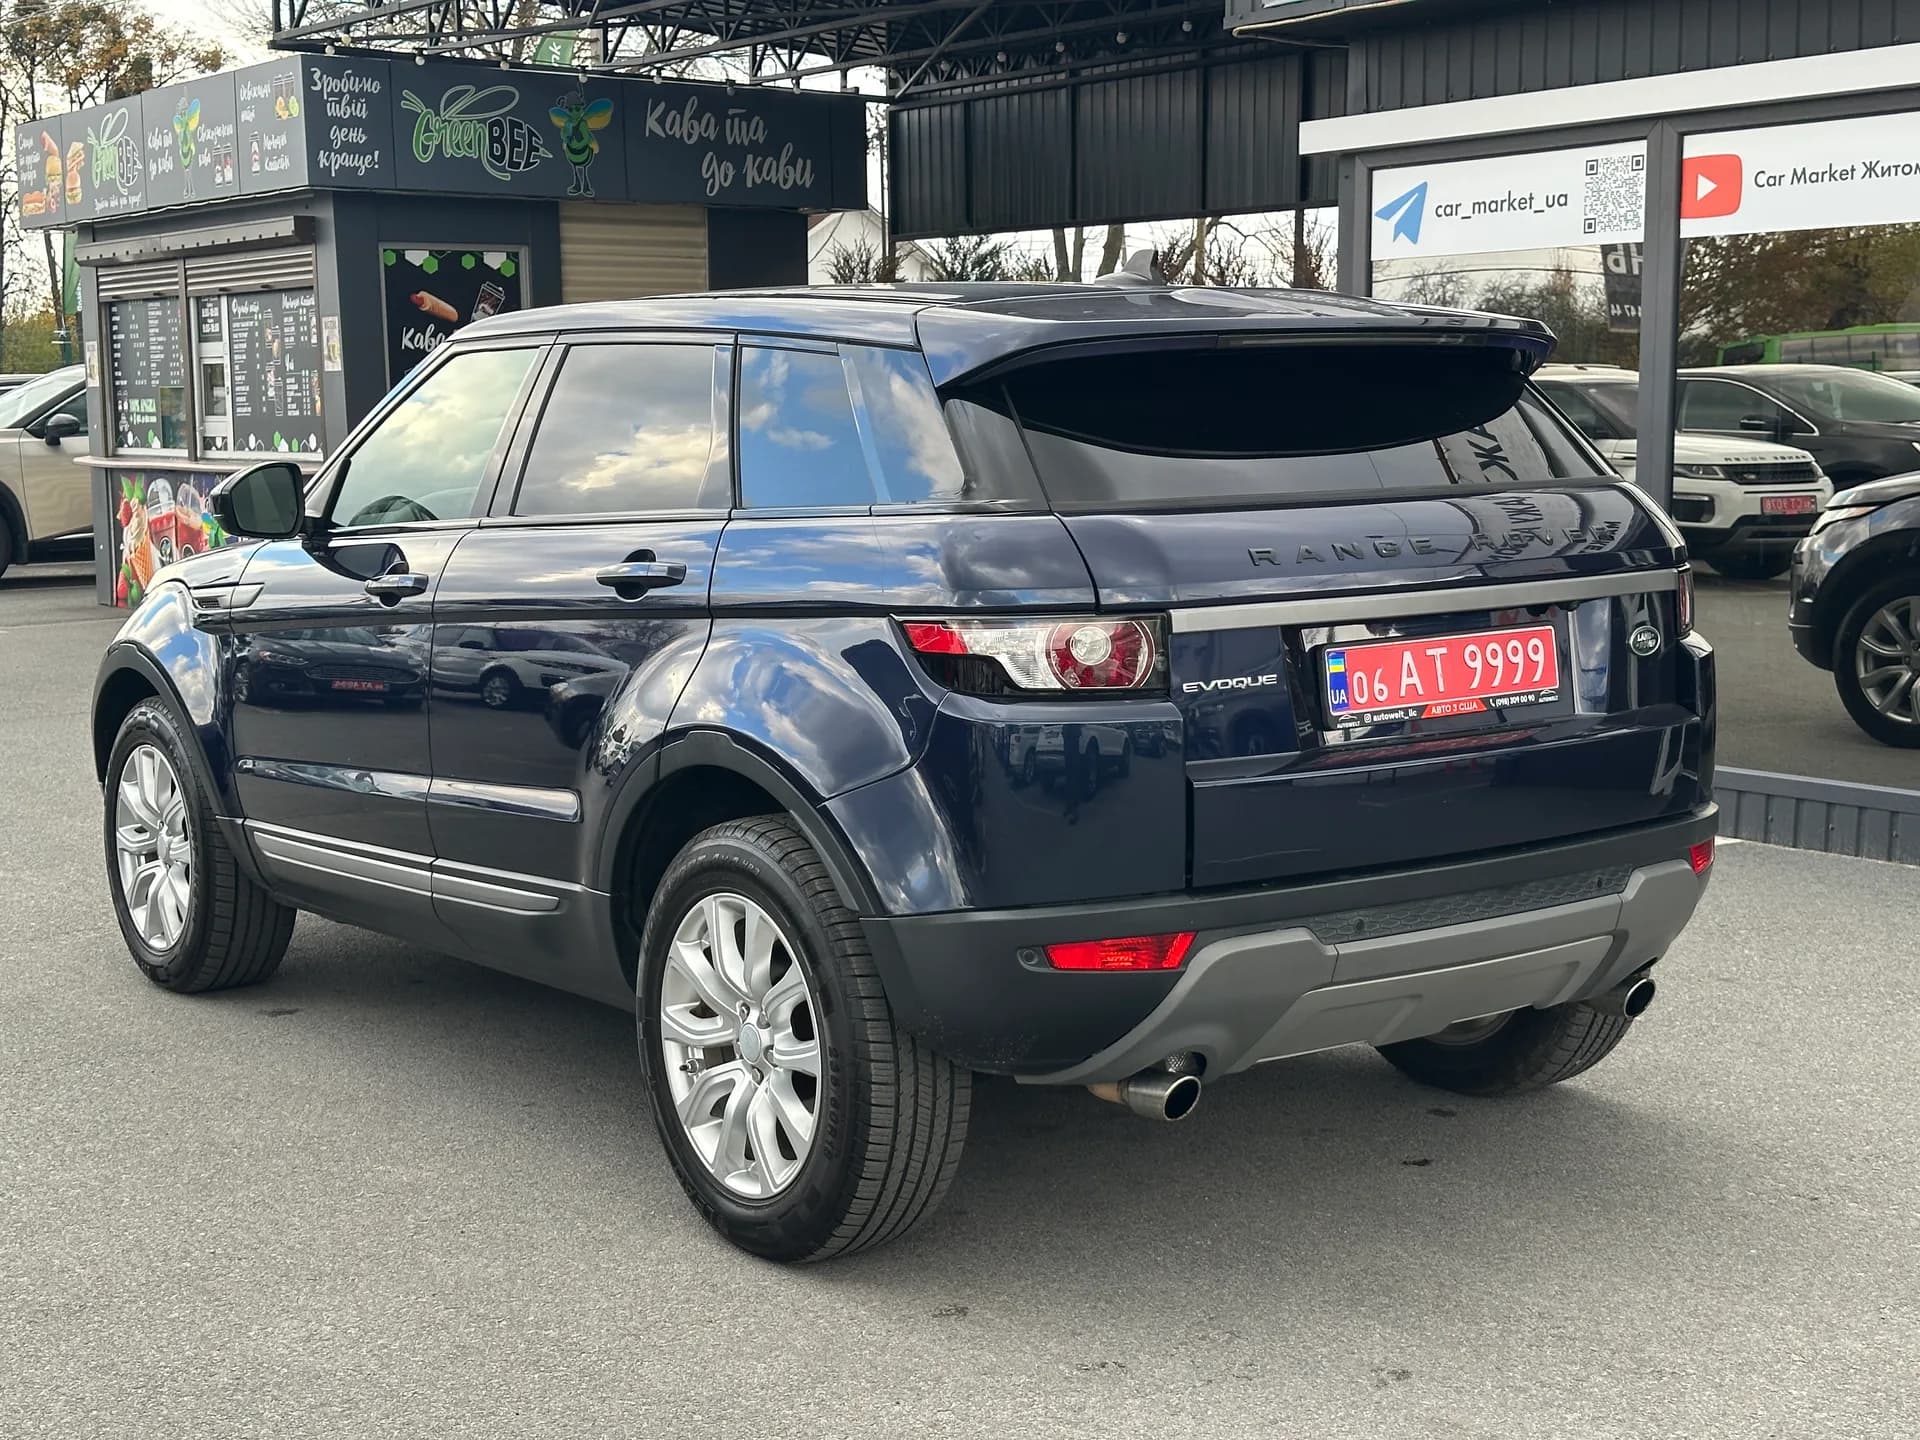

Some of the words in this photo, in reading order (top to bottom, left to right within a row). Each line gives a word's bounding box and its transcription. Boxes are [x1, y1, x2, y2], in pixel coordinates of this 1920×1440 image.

[310, 67, 382, 99] Зробимо
[326, 93, 368, 119] твій
[645, 96, 720, 144] Кава
[725, 108, 767, 146] та
[330, 124, 368, 149] день
[317, 150, 380, 177] краще!
[702, 151, 736, 196] до
[742, 142, 815, 190] кави
[1754, 170, 1786, 188] Car
[1790, 162, 1857, 185] Market
[1435, 190, 1569, 220] car_market_ua
[1248, 537, 1437, 566] RANGE
[1182, 674, 1278, 693] EVOQUE
[1352, 668, 1389, 704] 06
[1400, 647, 1448, 697] AT
[1463, 637, 1546, 690] 9999
[1331, 689, 1348, 705] UA
[1431, 704, 1451, 715] АВТО
[1459, 701, 1478, 711] США
